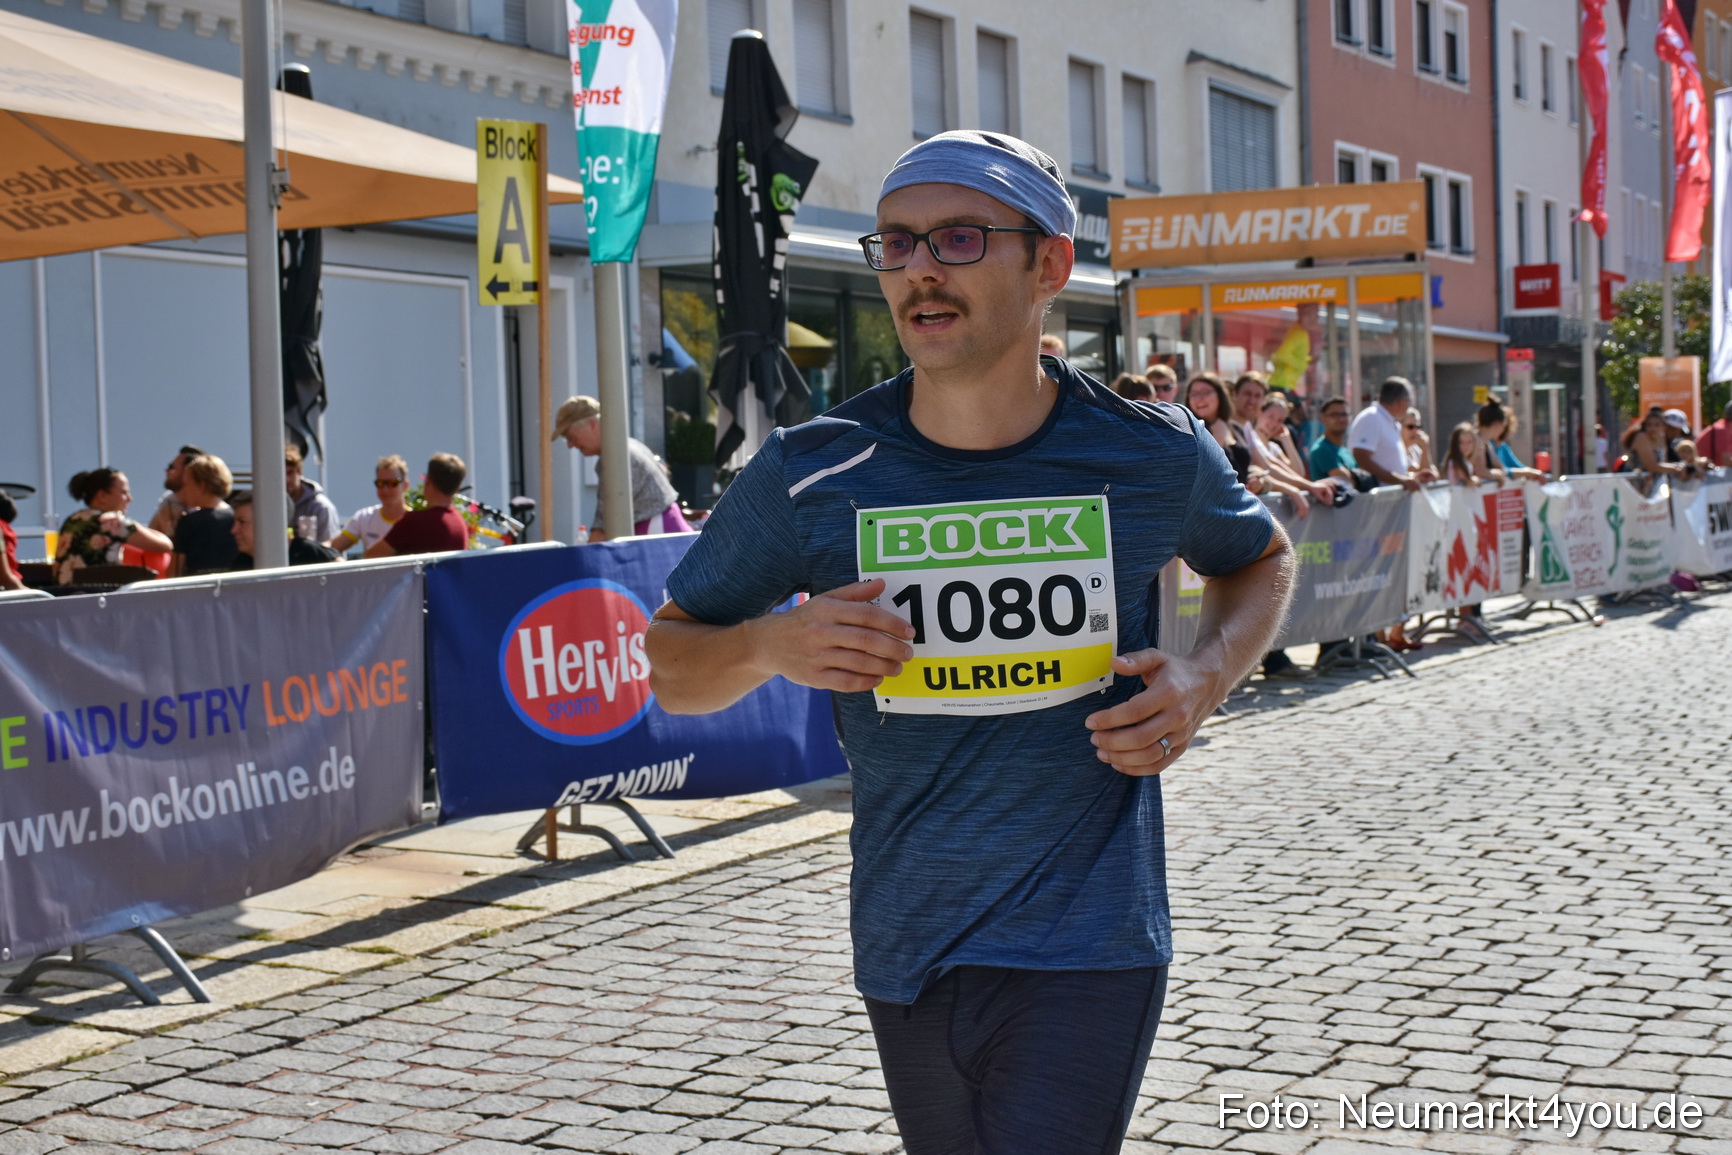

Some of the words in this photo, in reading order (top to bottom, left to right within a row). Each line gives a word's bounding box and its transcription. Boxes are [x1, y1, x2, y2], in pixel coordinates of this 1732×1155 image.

[485, 127, 538, 161] Block
[493, 176, 531, 264] A
[1119, 203, 1410, 252] RUNMARKT.DE
[877, 507, 1090, 563] BOCK
[892, 574, 1087, 644] 1080
[1090, 577, 1102, 589] D
[517, 620, 651, 703] Hervis
[923, 660, 1061, 691] ULRICH
[44, 683, 250, 763] INDUSTRY
[262, 658, 409, 727] LOUNGE
[547, 696, 600, 722] SPORTS
[553, 773, 613, 808] GET
[608, 751, 695, 801] MOVIN'
